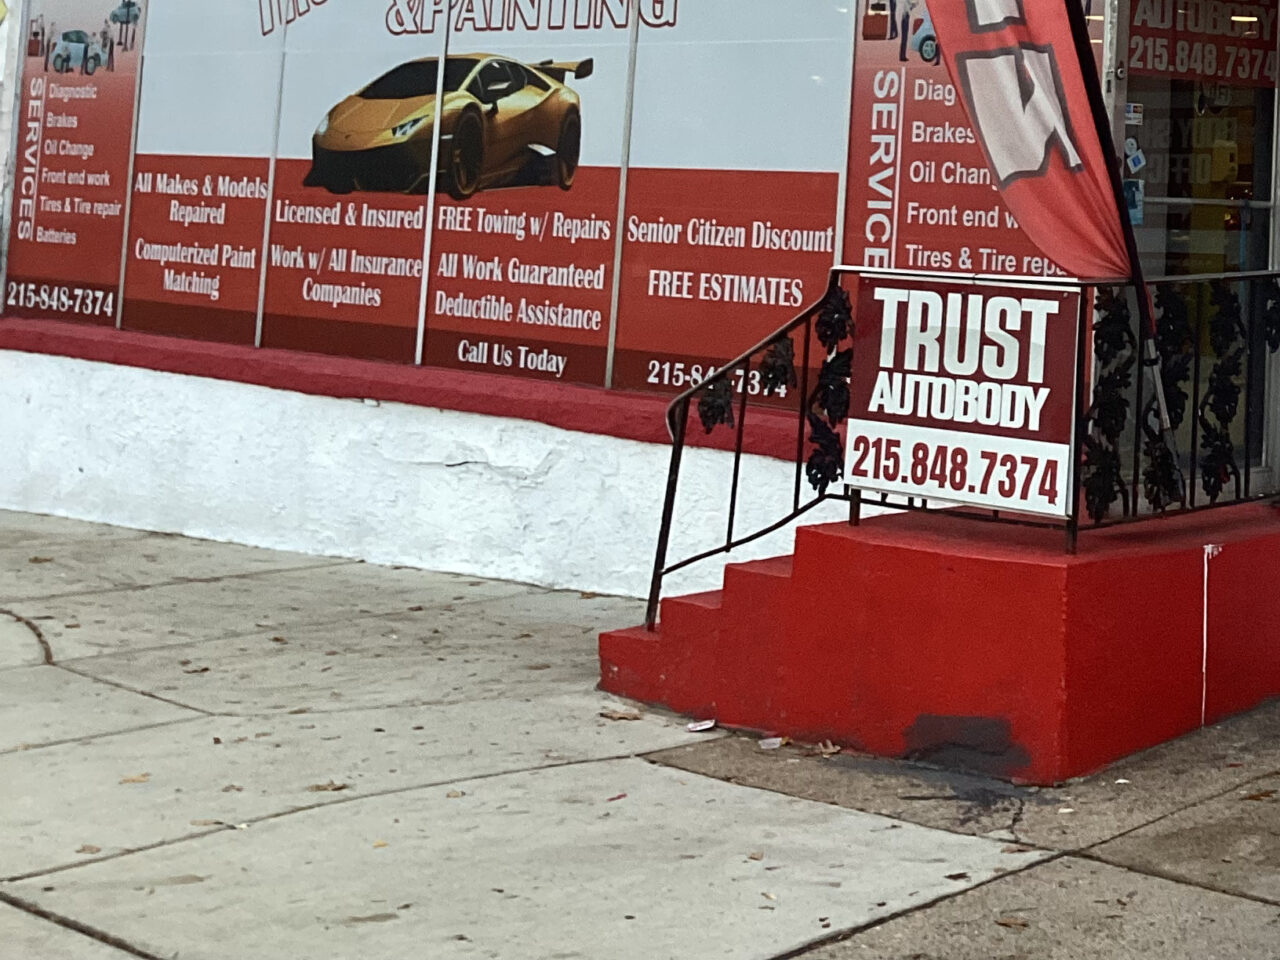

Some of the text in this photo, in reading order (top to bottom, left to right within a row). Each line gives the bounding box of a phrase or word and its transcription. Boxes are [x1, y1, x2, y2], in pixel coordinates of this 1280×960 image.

[1129, 35, 1277, 82] 215.848.7374
[48, 83, 98, 102] Diagnostic
[46, 112, 78, 128] Brakes
[911, 121, 976, 144] Brakes
[18, 77, 43, 240] SERVICES
[44, 140, 95, 160] Oil Change
[41, 168, 111, 186] Front end work
[863, 70, 899, 268] SERVICE
[909, 161, 936, 184] Oil
[135, 172, 268, 200] All Makes & Models
[40, 196, 62, 212] Tires
[64, 197, 71, 213] &
[74, 198, 92, 214] Tire
[169, 200, 226, 226] Repaired
[275, 200, 424, 229] Licensed & Insured
[906, 202, 957, 225] Front
[962, 206, 999, 228] end
[36, 226, 77, 245] Batteries
[438, 206, 611, 244] FREE Towing w/ Repairs
[628, 216, 833, 252] Senior Citizen Discount
[135, 238, 256, 269] Computerized Paint
[271, 244, 423, 278] Work w/ All Insurance
[905, 244, 952, 268] Tires
[958, 246, 973, 270] &
[979, 248, 1017, 272] Tire
[163, 269, 220, 300] Matching
[437, 253, 606, 290] All Work Guaranteed
[7, 281, 114, 317] 215-848-7374
[303, 277, 382, 308] Companies
[648, 270, 803, 307] FREE ESTIMATES
[435, 290, 602, 330] Deductible Assistance
[874, 287, 1060, 384] TRUST
[458, 340, 568, 378] Call Us Today
[868, 370, 1051, 431] AUTOBODY
[851, 435, 1059, 506] 215.848.7374
